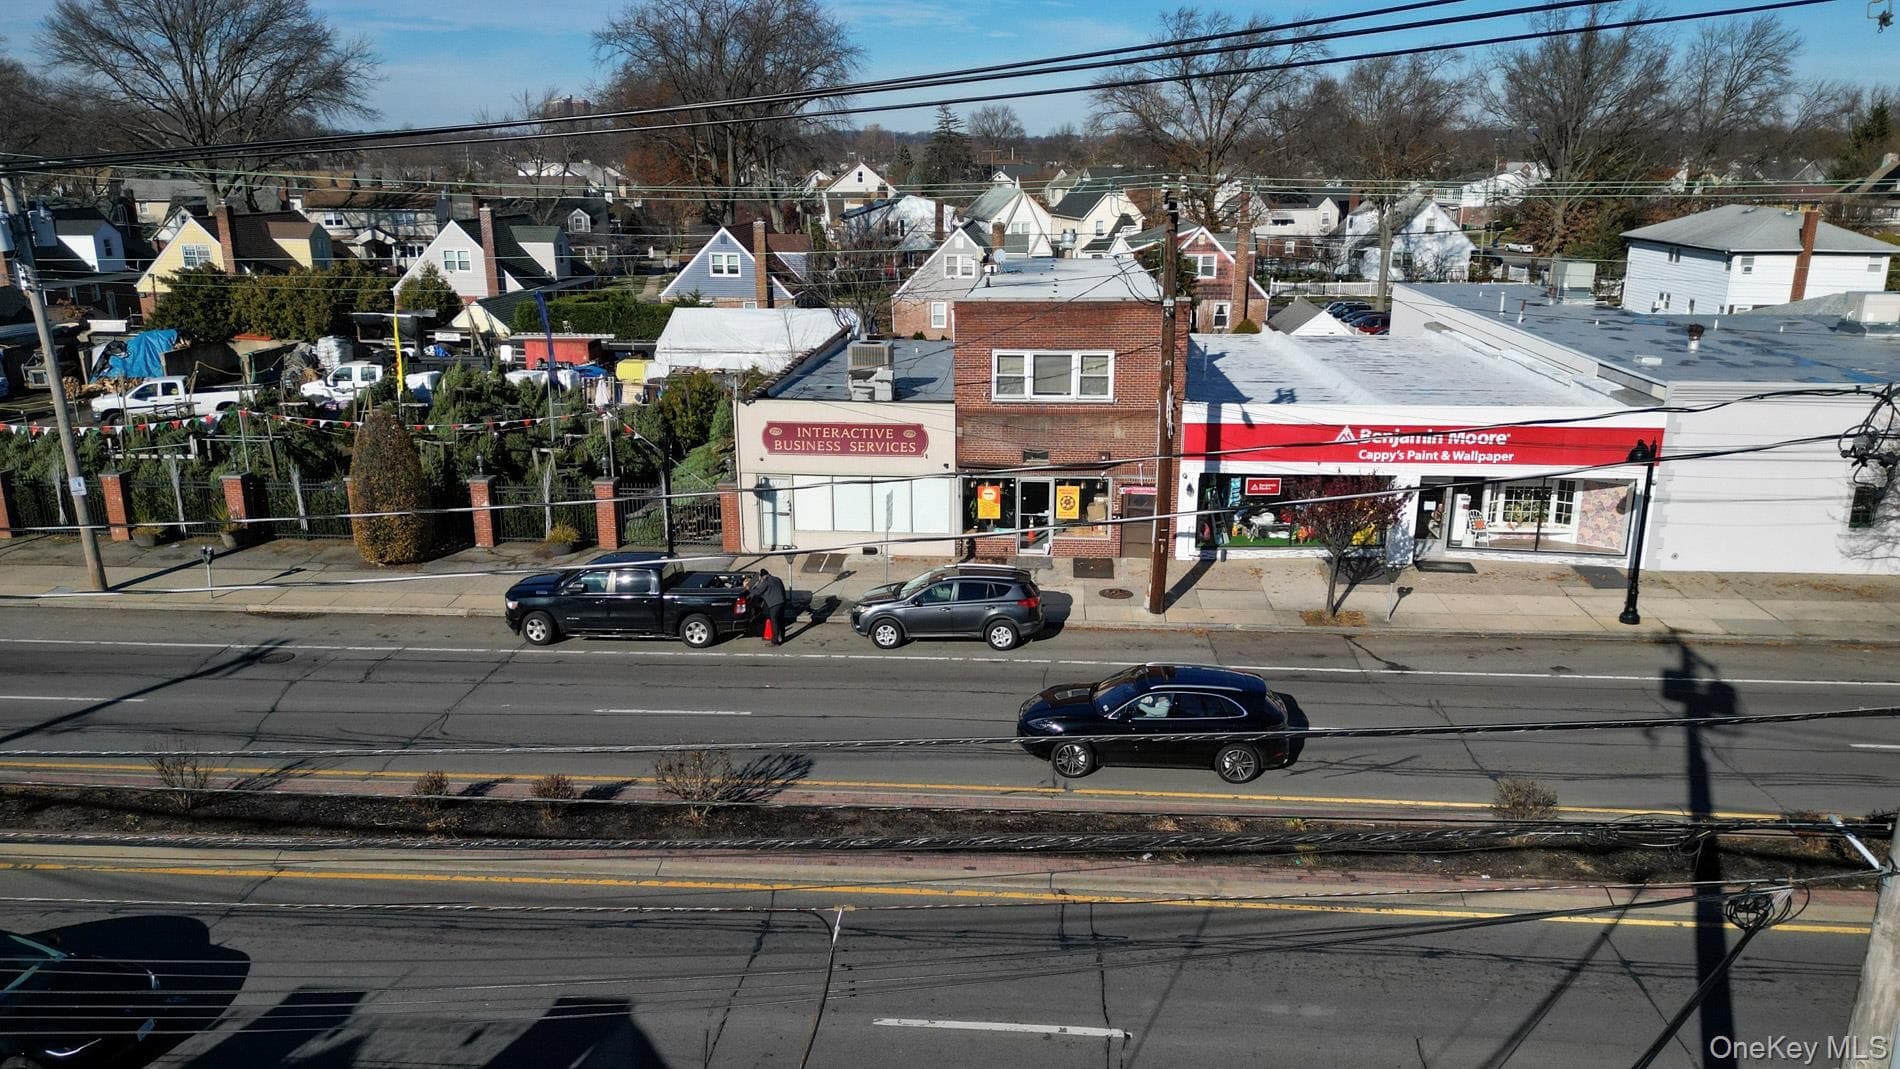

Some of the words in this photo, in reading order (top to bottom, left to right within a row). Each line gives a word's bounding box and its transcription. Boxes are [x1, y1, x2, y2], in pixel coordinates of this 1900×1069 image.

[797, 427, 894, 439] INTERACTIVE
[1359, 428, 1443, 447] Benjamin
[774, 440, 841, 451] BUSINESS
[849, 441, 917, 453] SERVICES
[1358, 449, 1405, 462] Cappy's
[1407, 450, 1438, 461] Paint
[1441, 451, 1450, 461] &
[1453, 451, 1514, 463] Wallpaper
